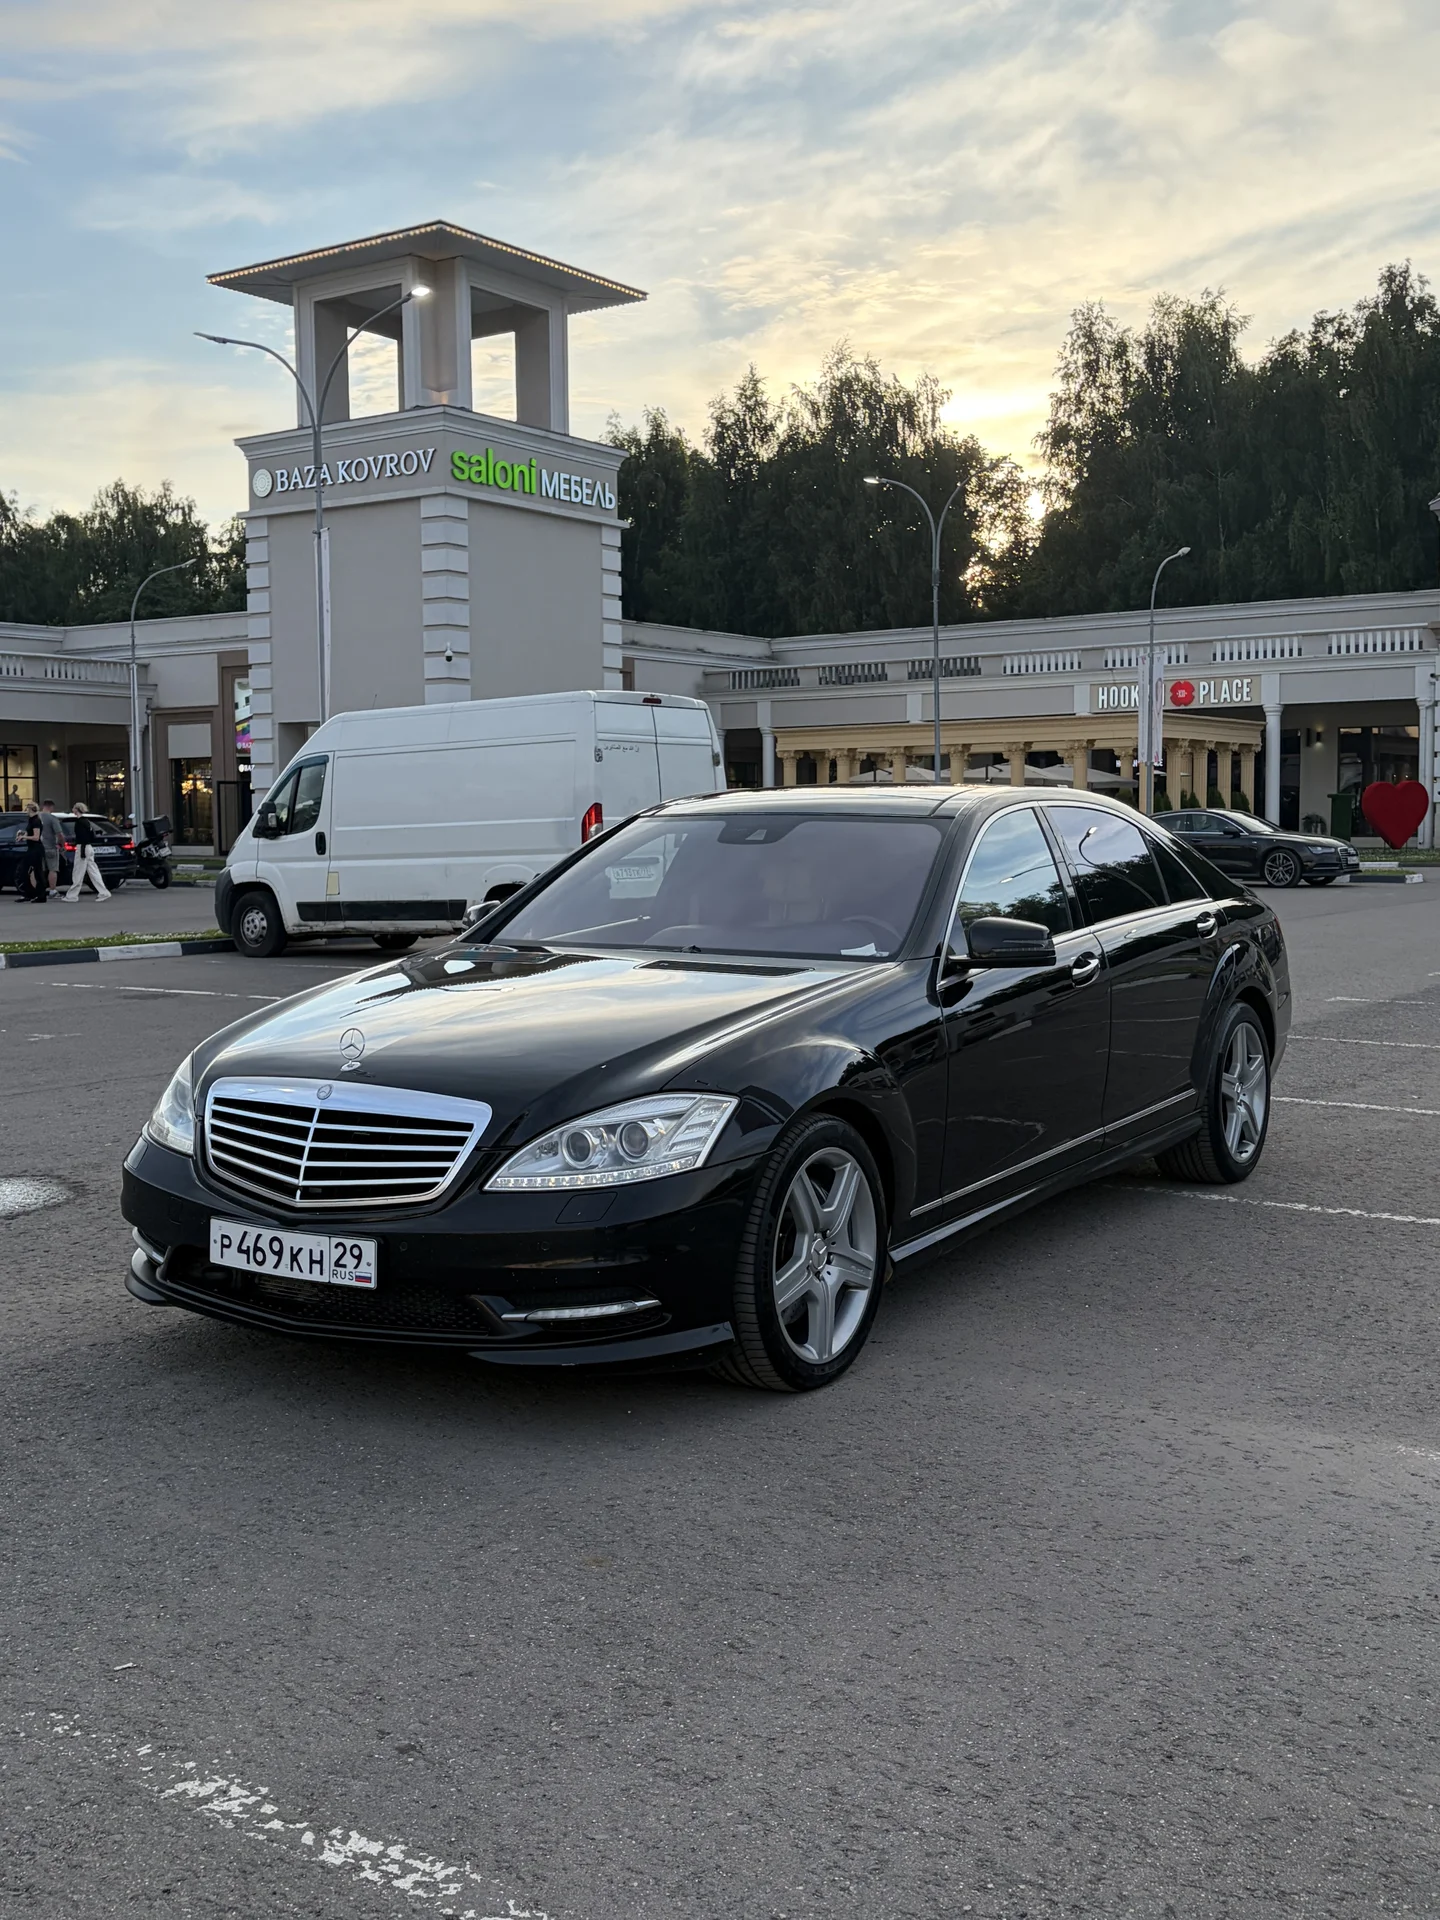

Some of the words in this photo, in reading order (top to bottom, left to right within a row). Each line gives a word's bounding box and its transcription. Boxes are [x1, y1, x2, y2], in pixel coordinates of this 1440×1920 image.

[275, 463, 333, 492] BAZA
[336, 448, 435, 483] KOVROV
[451, 448, 537, 494] saloni
[541, 469, 616, 510] МЕБЕЛЬ
[1098, 682, 1165, 709] HOOK
[1199, 678, 1252, 704] PLACE
[220, 1231, 324, 1276] Р469КН
[334, 1242, 363, 1269] 29
[332, 1269, 354, 1281] RUS
